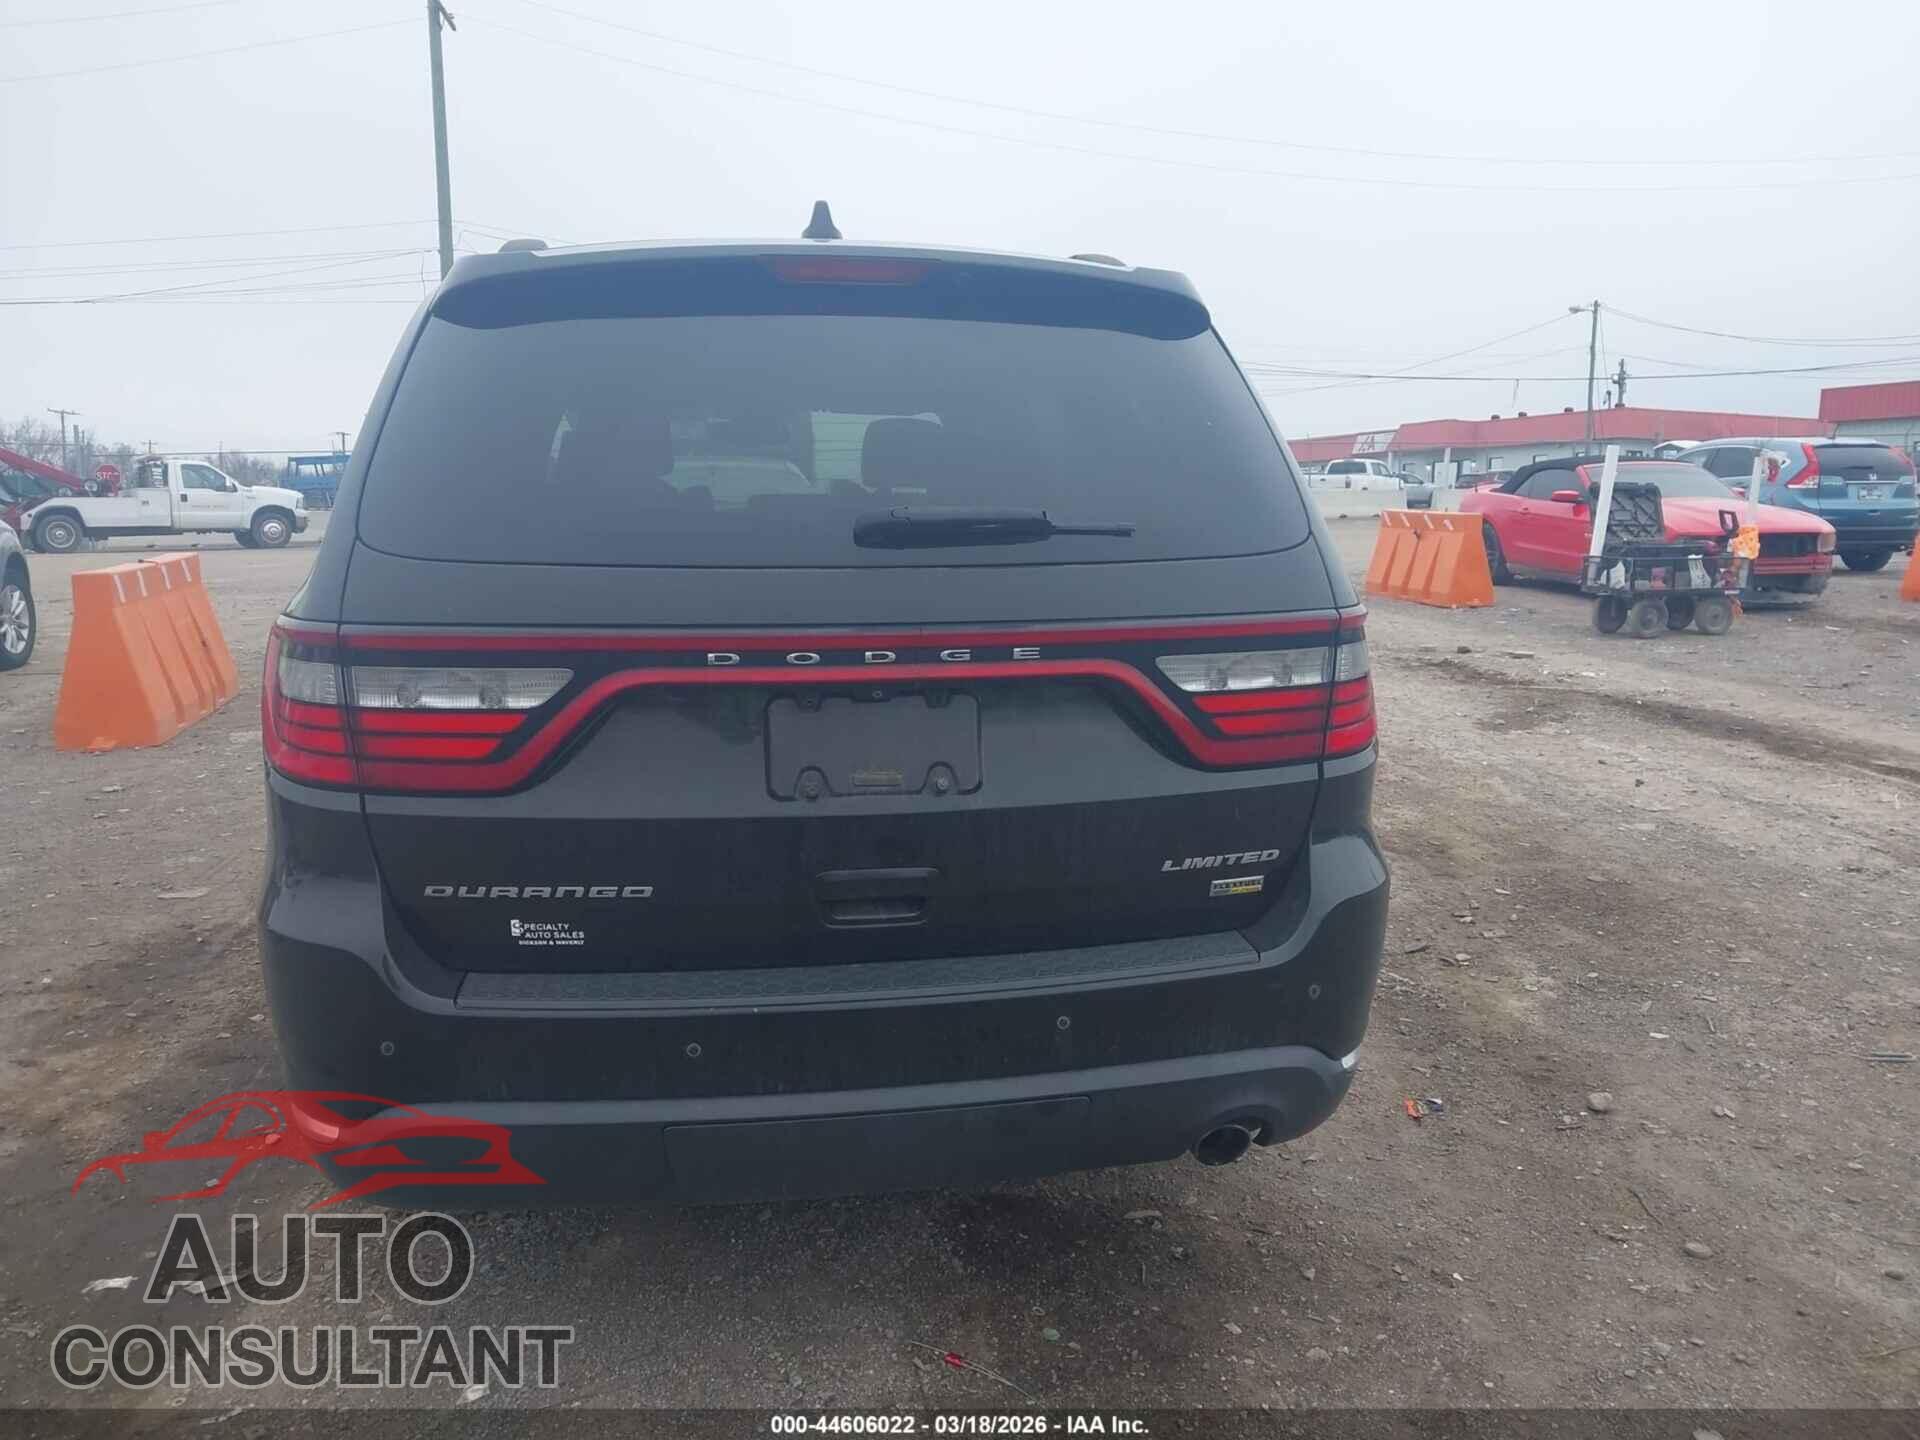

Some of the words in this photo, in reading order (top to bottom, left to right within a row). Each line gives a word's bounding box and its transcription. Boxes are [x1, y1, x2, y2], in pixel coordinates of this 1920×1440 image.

[707, 647, 1040, 665] DODGE
[1161, 849, 1280, 871] LIMITED
[423, 885, 654, 898] DURANGO
[511, 920, 569, 936] SPECIALTY
[525, 931, 551, 939] AUTO
[554, 931, 584, 939] SALES
